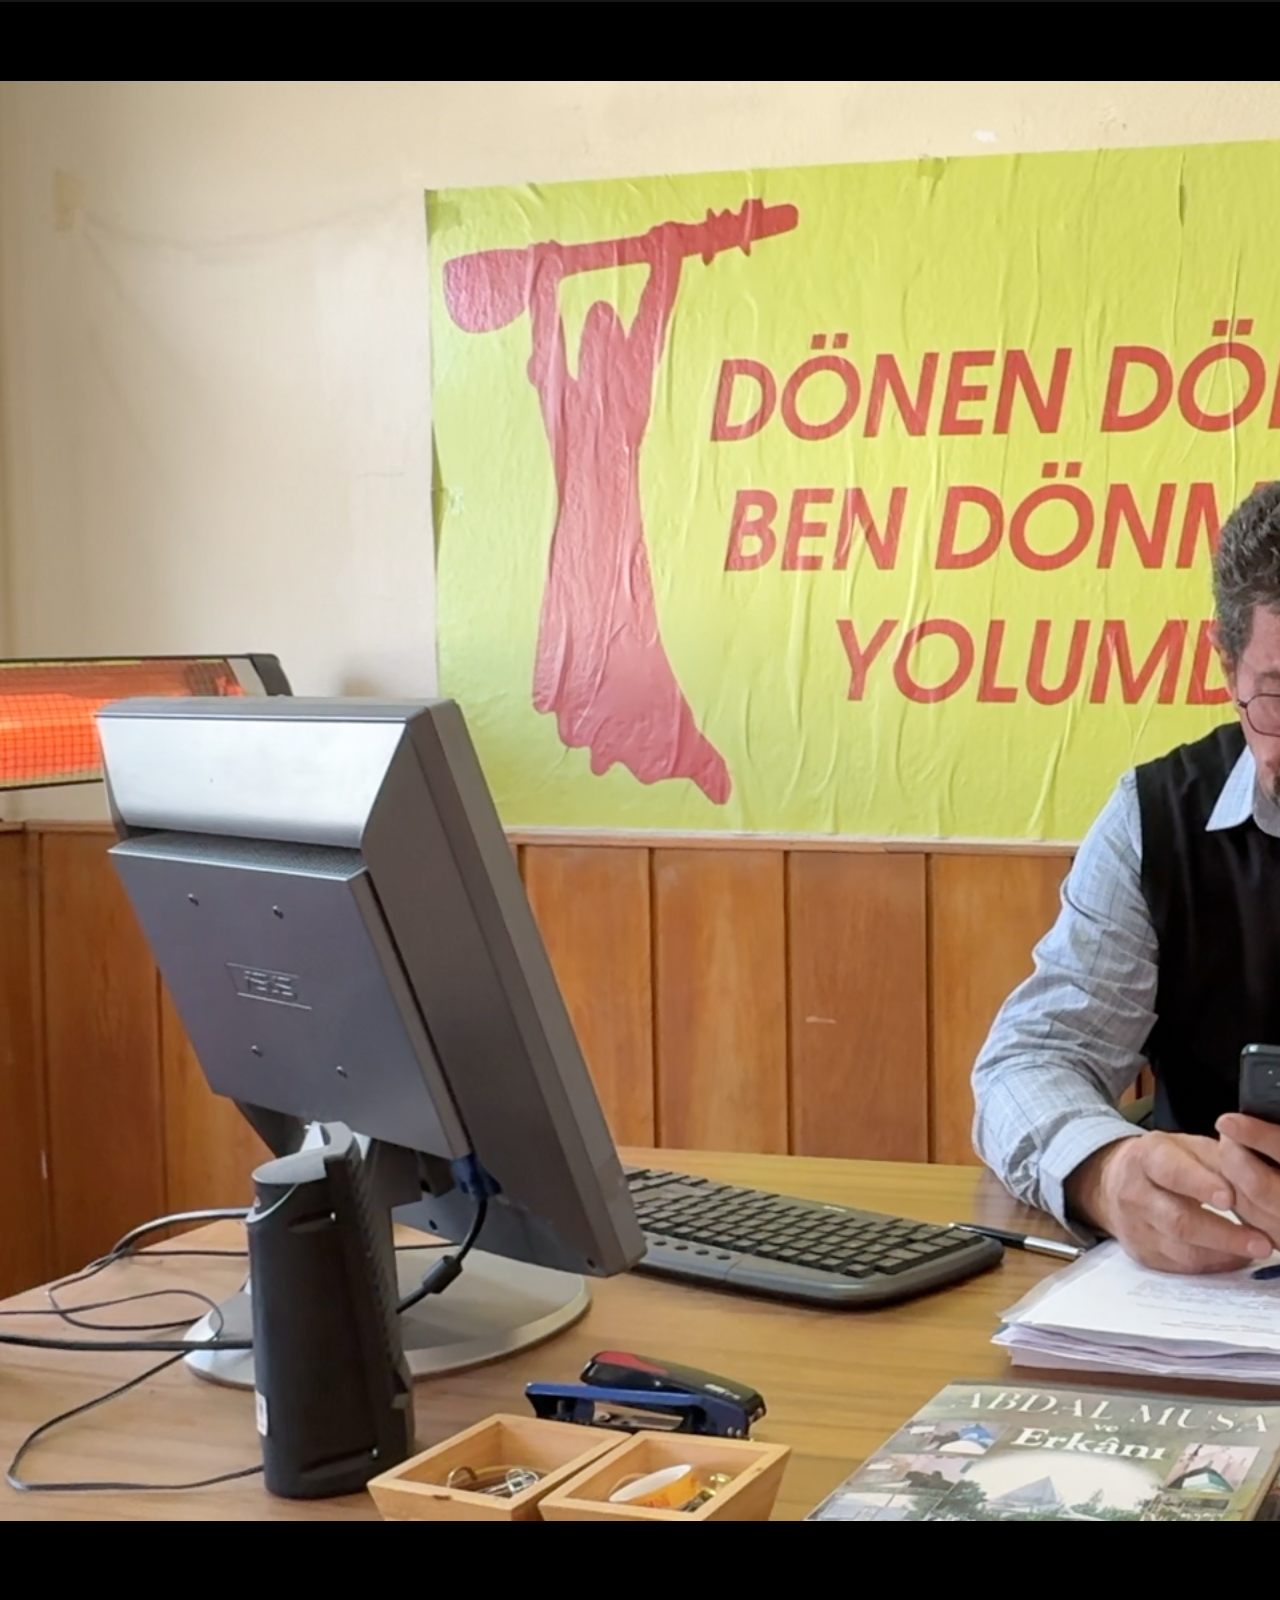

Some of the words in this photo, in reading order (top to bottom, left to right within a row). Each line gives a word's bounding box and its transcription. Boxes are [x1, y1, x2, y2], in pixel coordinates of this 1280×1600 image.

[712, 333, 1072, 441] DÖNEN
[725, 486, 907, 572] BEN
[952, 1391, 1113, 1421] ABDAL
[1129, 1404, 1270, 1434] MUSA
[1093, 1423, 1121, 1435] ve
[1010, 1426, 1168, 1461] Erkânı
